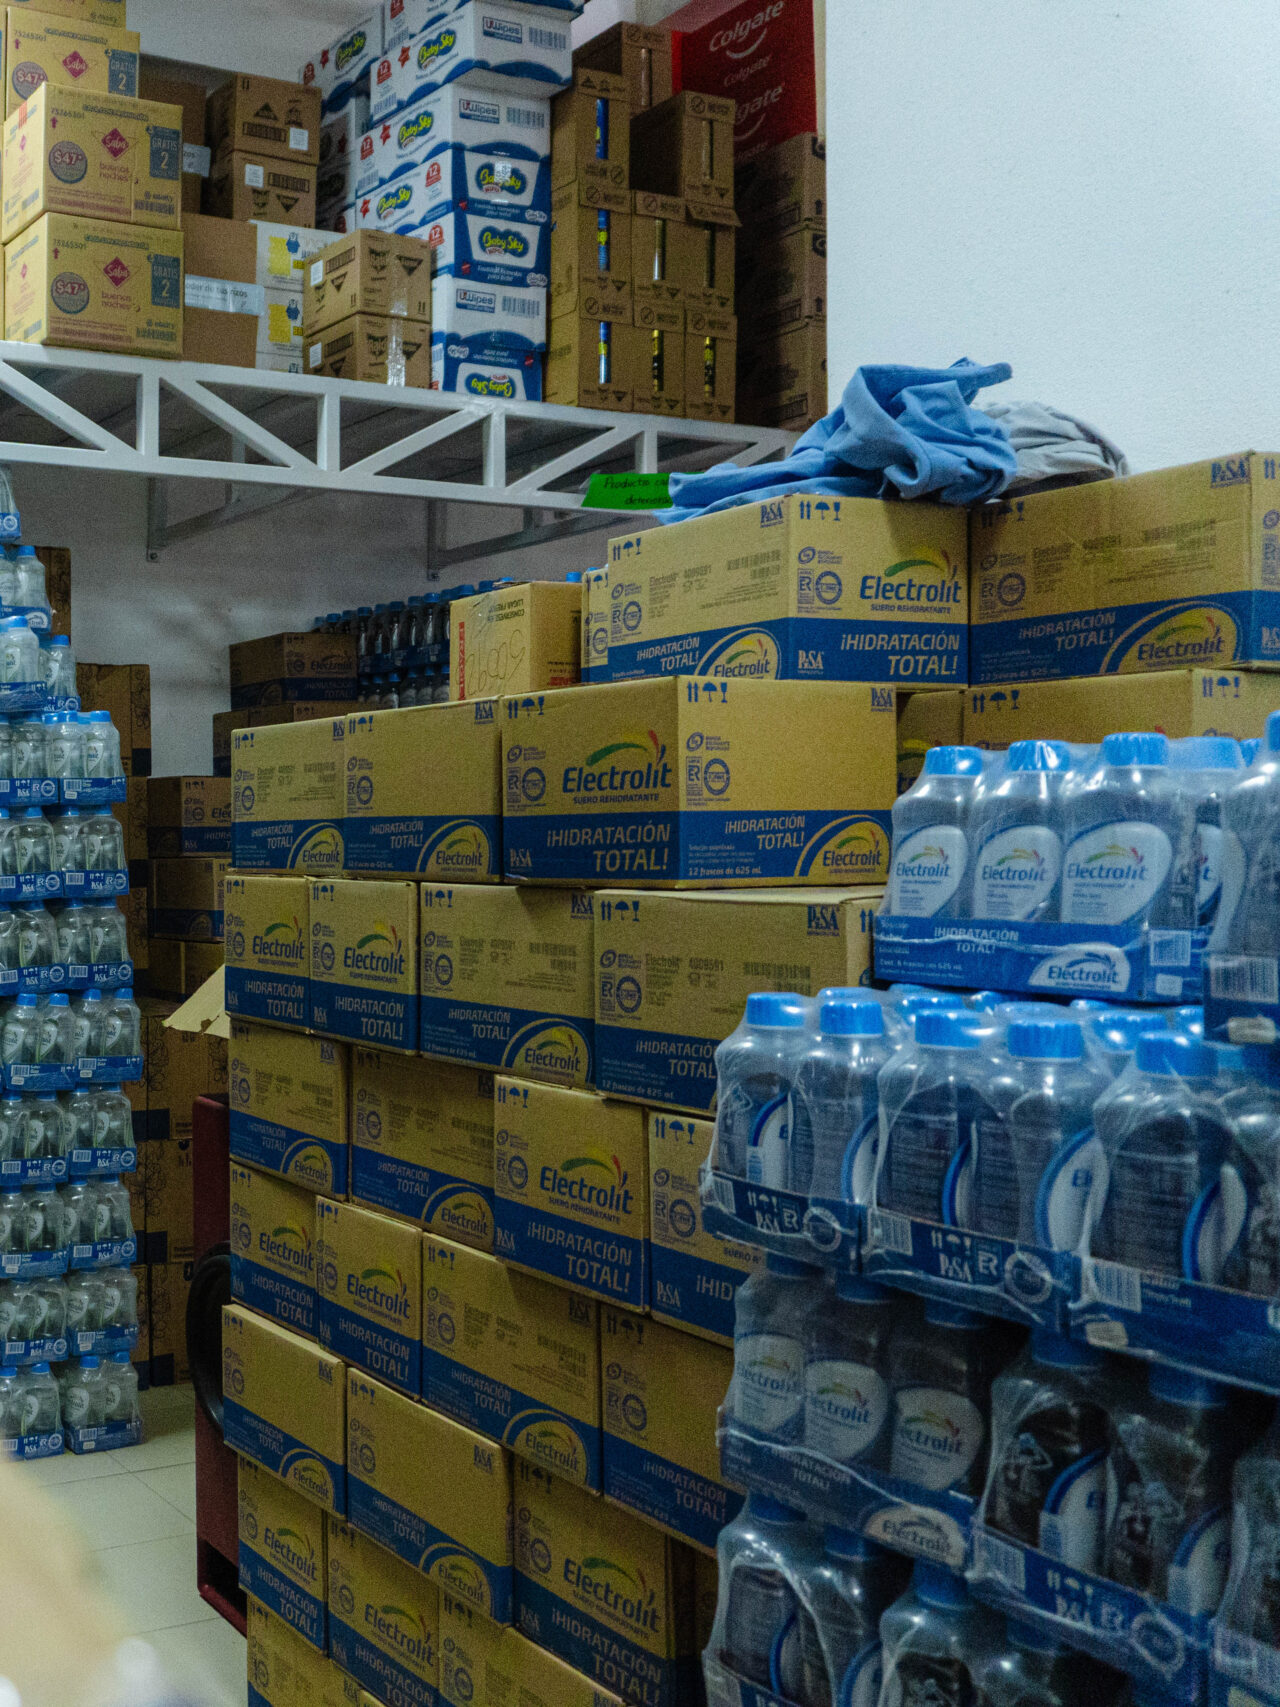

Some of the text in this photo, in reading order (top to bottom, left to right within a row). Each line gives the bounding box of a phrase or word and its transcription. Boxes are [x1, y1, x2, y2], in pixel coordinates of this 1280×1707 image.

[709, 0, 783, 51] Colgate
[119, 74, 127, 91] 2
[160, 152, 168, 170] 2
[429, 162, 439, 176] 12
[431, 225, 440, 239] 12
[483, 231, 524, 252] Baby Sky
[162, 280, 170, 297] 2
[471, 378, 512, 397] Baby Sky
[859, 568, 962, 604] Electrolit
[870, 603, 951, 614] SUERO REHIDRATANTE
[636, 635, 700, 661] ¡HIDRATACIÓN
[841, 629, 960, 652] ¡HIDRATACIÓN
[1055, 627, 1115, 652] TOTAL!
[1137, 627, 1225, 661] Electrolit
[659, 650, 699, 672] TOTAL!
[713, 655, 770, 678] Electrolit
[888, 654, 957, 676] TOTAL!
[562, 757, 672, 794] Electrolit
[547, 822, 671, 848] ¡HIDRATACIÓN
[724, 814, 806, 834] ¡HIDRATACIÓN
[267, 836, 294, 850] TOTAL!
[390, 835, 424, 849] TOTAL!
[756, 832, 805, 850] TOTAL!
[302, 846, 340, 864] Electrolit
[435, 846, 483, 867] Electrolit
[593, 850, 668, 873] TOTAL!
[823, 843, 882, 868] Electrolit
[688, 867, 698, 876] 12
[700, 867, 724, 877] frascos
[725, 867, 734, 875] de
[735, 866, 750, 875] 625
[896, 859, 951, 878] Electrolit
[982, 860, 1048, 882] Electrolit
[1067, 858, 1148, 881] Electrolit
[252, 930, 305, 961] Electrolit
[344, 941, 406, 975] Electrolit
[955, 941, 996, 954] TOTAL!
[1047, 960, 1120, 985] Electrolit
[244, 981, 305, 999] ¡HIDRATACIÓN
[267, 1000, 304, 1019] TOTAL!
[335, 996, 405, 1018] ¡HIDRATACIÓN
[448, 1008, 511, 1024] ¡HIDRATACIÓN
[361, 1017, 404, 1041] TOTAL!
[472, 1023, 510, 1041] TOTAL!
[524, 1043, 581, 1073] Electrolit
[669, 1058, 717, 1079] TOTAL
[294, 1155, 329, 1183] Electrolit
[397, 1179, 430, 1197] TOTAL!
[540, 1166, 633, 1215] Electrolit
[441, 1205, 488, 1236] Electrolit
[259, 1228, 315, 1272] Electrolit
[527, 1221, 633, 1267] ¡HIDRATACIÓN
[566, 1254, 630, 1293] TOTAL!
[251, 1273, 314, 1308] ¡HIDRATACIÓN
[347, 1272, 411, 1319] Electrolit
[274, 1298, 314, 1328] TOTAL!
[338, 1316, 411, 1361] ¡HIDRATACIÓN
[364, 1347, 409, 1381] TOTAL!
[473, 1391, 512, 1417] TOTAL!
[525, 1429, 580, 1473] Electrolit
[293, 1464, 330, 1500] Electrolit
[642, 1459, 726, 1506] ¡HIDRATACIÓN
[675, 1488, 726, 1523] TOTAL!
[392, 1519, 426, 1547] TOTAL!
[264, 1526, 318, 1582] Electrolit
[257, 1565, 318, 1619] ¡HIDRATACIÓN
[438, 1563, 484, 1602] Electrolit
[563, 1555, 662, 1635] Electrolit
[279, 1597, 318, 1639] TOTAL!
[364, 1602, 435, 1667] Electrolit
[551, 1607, 661, 1684] ¡HIDRATACIÓN
[355, 1643, 433, 1707] ¡HIDRATACIÓN
[593, 1653, 661, 1704] TOTAL!
